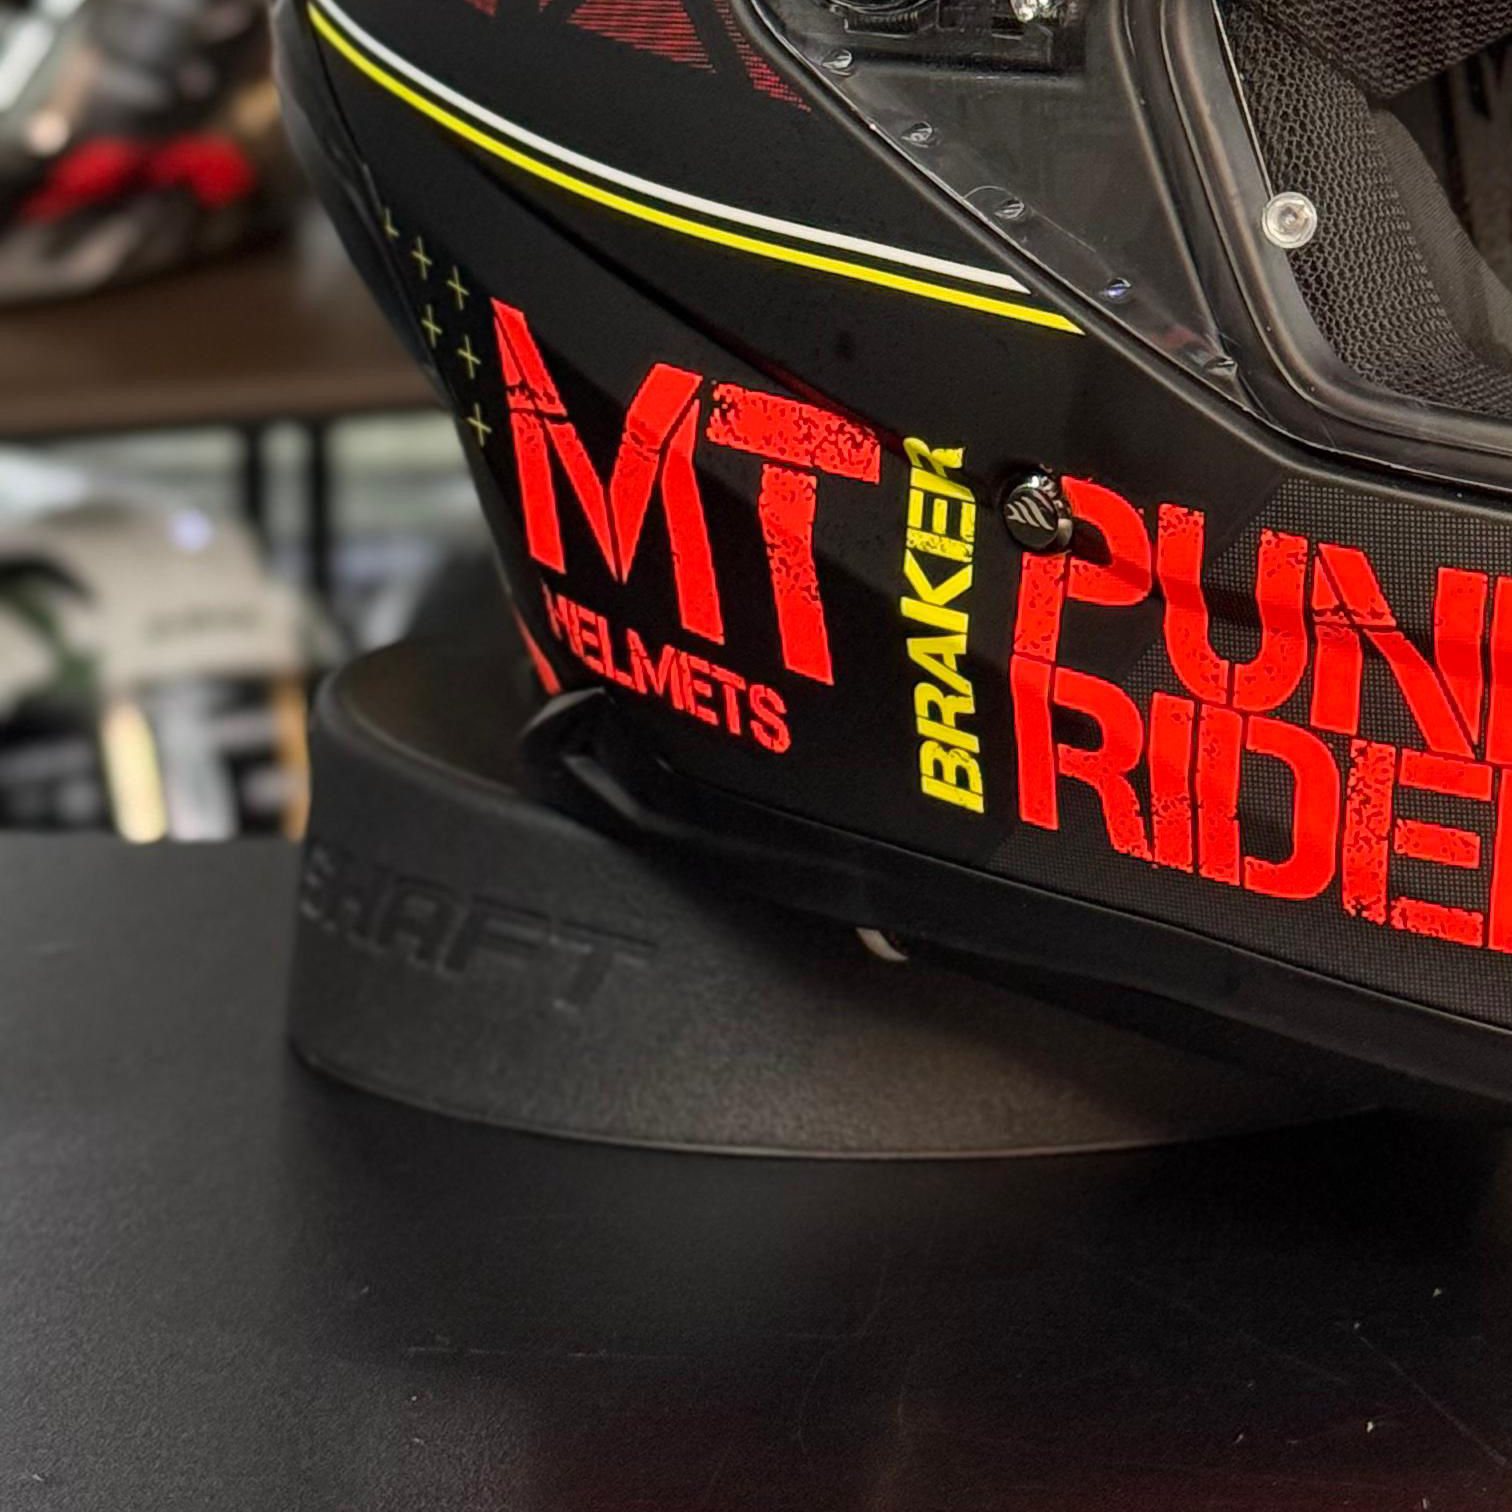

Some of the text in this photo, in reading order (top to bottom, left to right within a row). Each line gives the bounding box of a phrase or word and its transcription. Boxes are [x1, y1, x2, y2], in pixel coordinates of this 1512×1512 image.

[490, 297, 881, 686] MT
[542, 583, 792, 754] HELMETS
[900, 436, 984, 813] BRAKER
